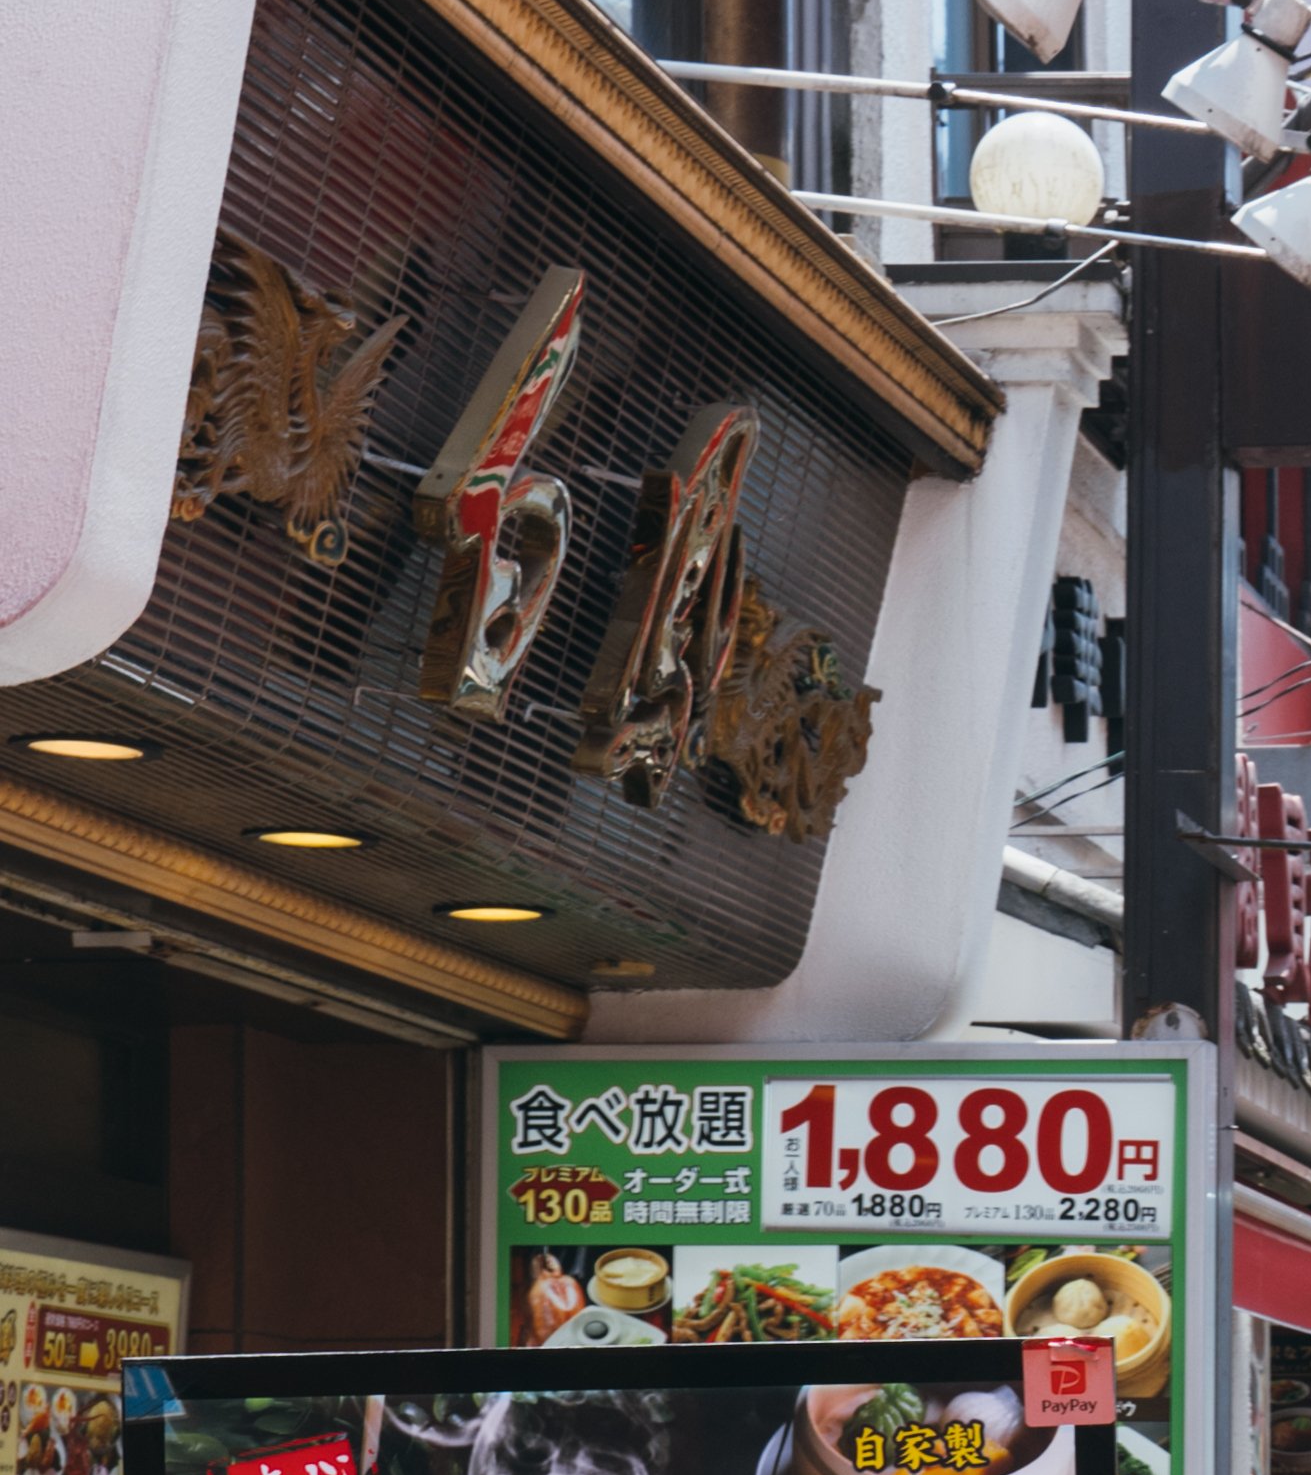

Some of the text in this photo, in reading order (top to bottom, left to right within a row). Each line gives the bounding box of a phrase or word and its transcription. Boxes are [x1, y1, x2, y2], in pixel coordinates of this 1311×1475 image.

[511, 1085, 752, 1154] 食べ放題
[522, 1164, 606, 1184] プレミアム
[782, 1137, 801, 1192] お一人様
[622, 1166, 752, 1196] オーダー式
[517, 1188, 615, 1224] 130品
[622, 1199, 751, 1225] 時間無制限
[1058, 1196, 1158, 1223] 2,280円
[1041, 1398, 1098, 1415] PayPay
[851, 1417, 991, 1473] 自家製
